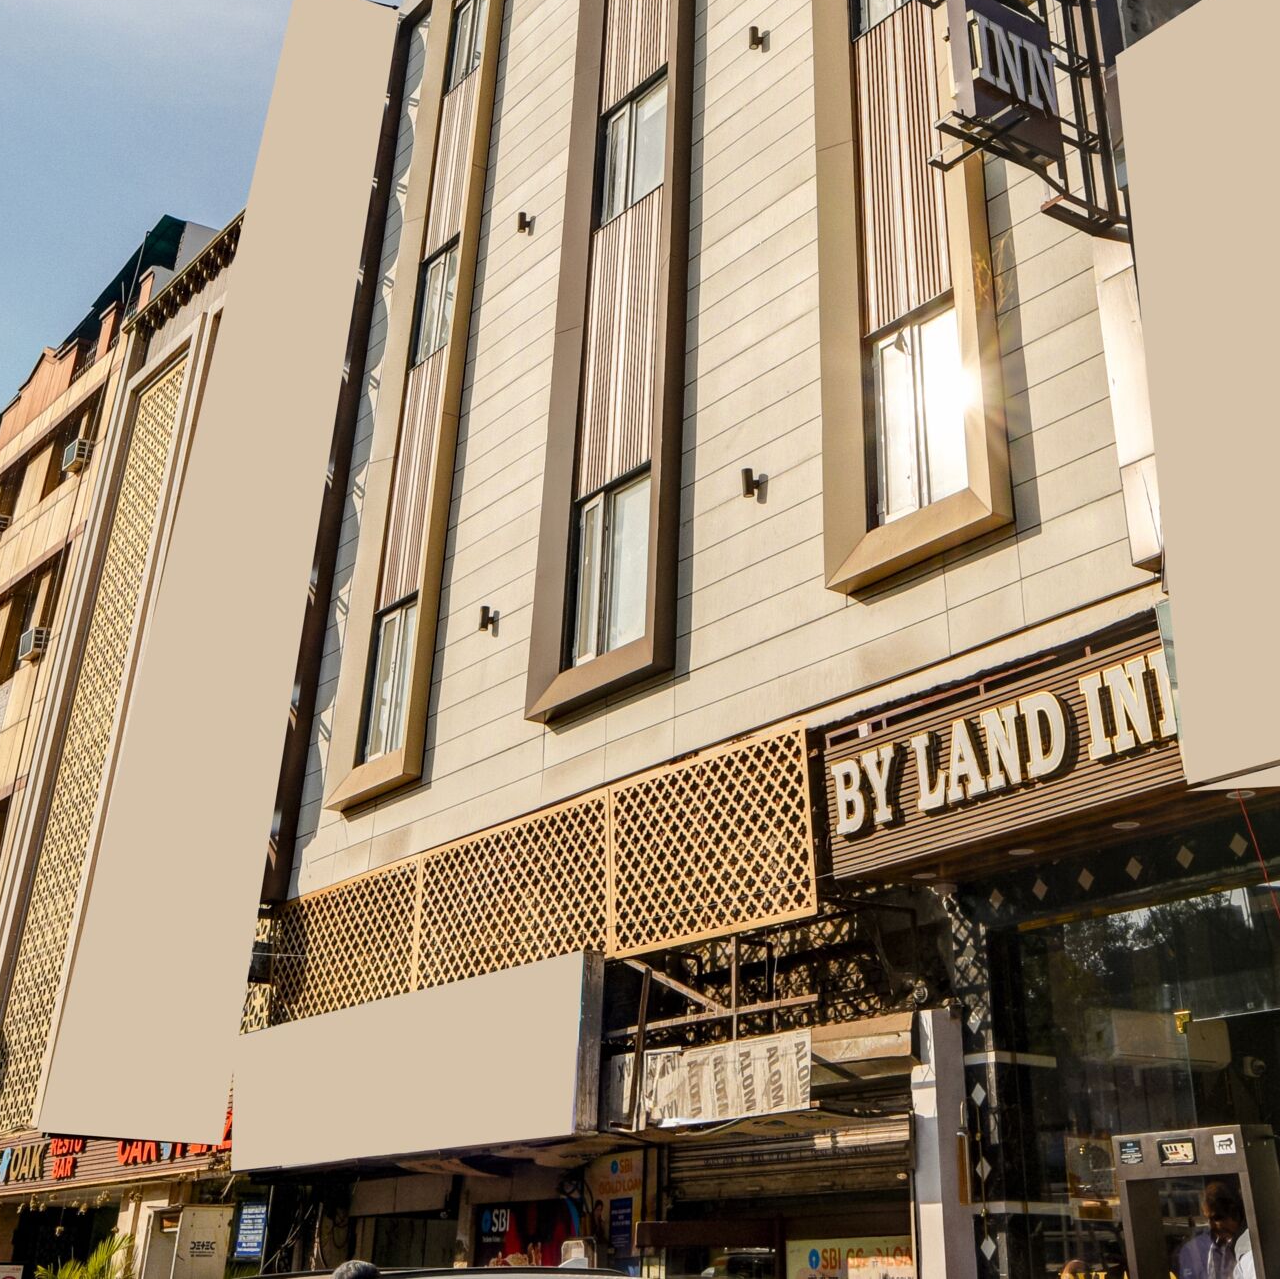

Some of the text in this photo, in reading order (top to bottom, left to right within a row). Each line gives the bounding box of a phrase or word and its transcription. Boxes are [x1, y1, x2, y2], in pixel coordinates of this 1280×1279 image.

[976, 11, 1058, 118] INN
[830, 742, 897, 835] BY
[910, 690, 1067, 811] LAND
[9, 1144, 45, 1180] OAK
[50, 1156, 73, 1179] BAR
[491, 1208, 511, 1232] SBI
[821, 1248, 841, 1270] SBI
